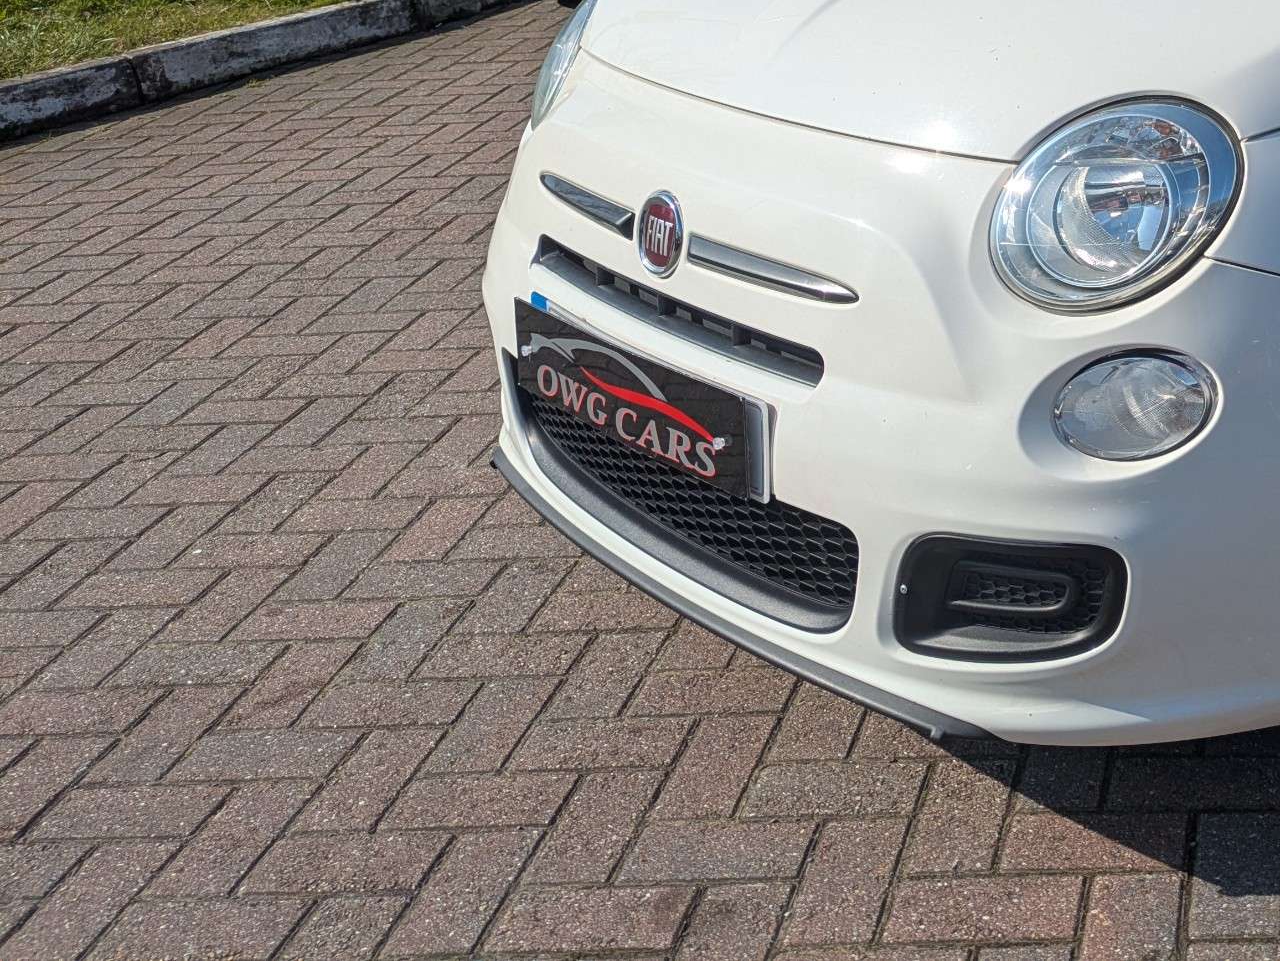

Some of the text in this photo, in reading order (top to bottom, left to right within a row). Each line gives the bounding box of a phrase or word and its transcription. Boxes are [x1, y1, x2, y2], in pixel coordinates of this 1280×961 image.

[645, 214, 674, 257] FIAT
[536, 364, 717, 477] OWG CARS
